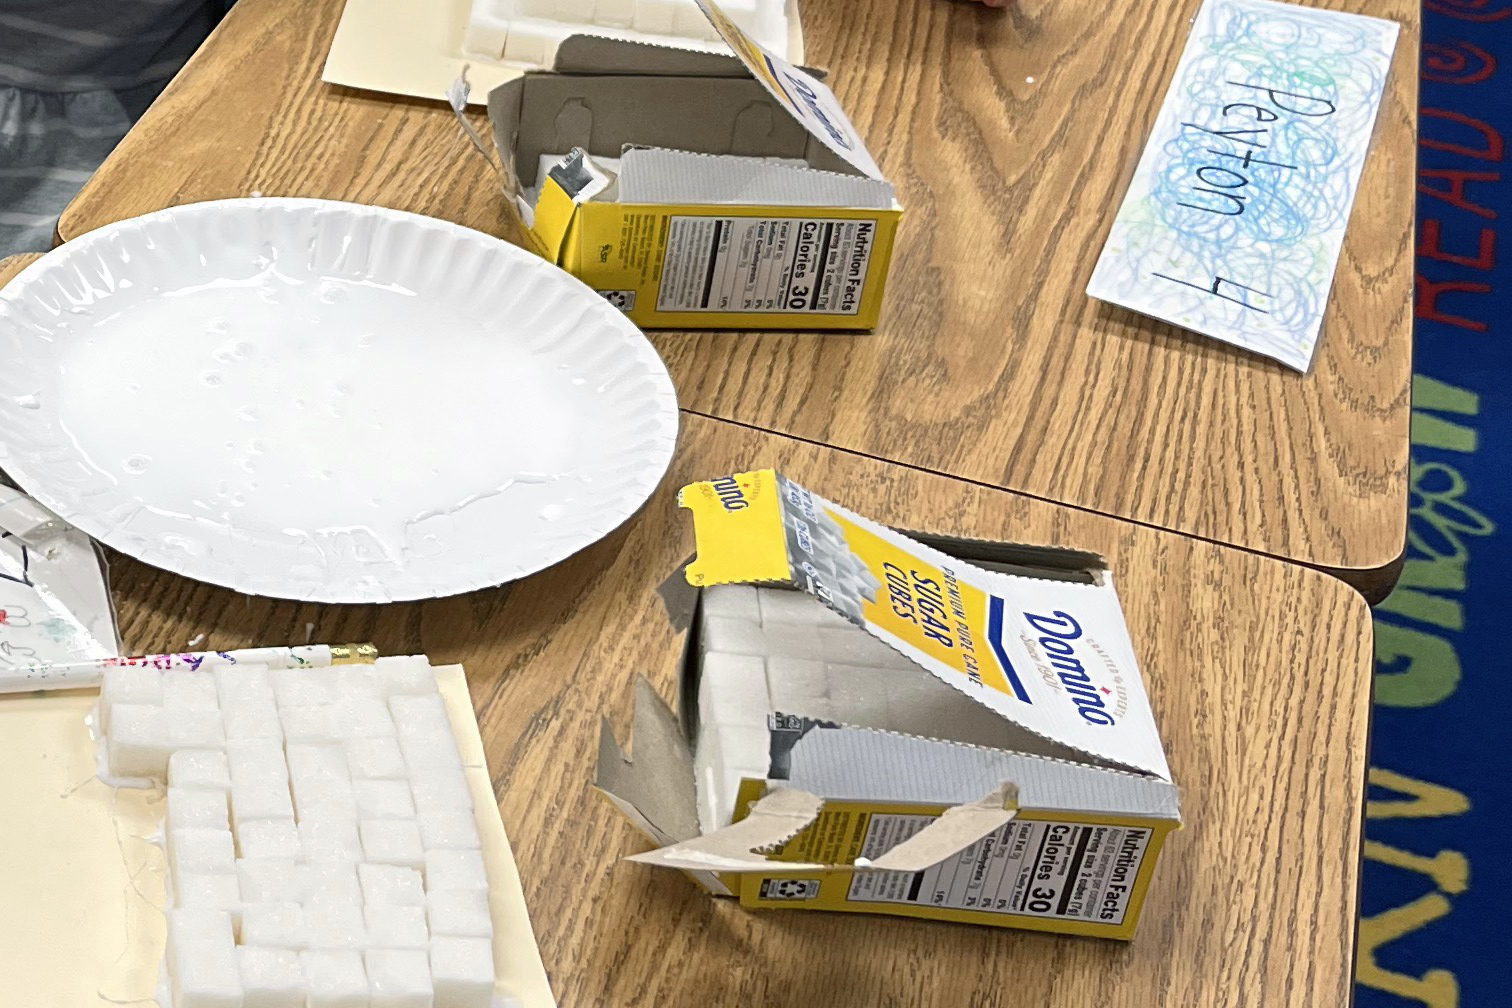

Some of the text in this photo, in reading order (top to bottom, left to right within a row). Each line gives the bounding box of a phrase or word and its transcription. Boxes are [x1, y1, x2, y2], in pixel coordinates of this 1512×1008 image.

[1180, 80, 1337, 216] Peyton
[789, 222, 817, 309] Calories 30
[841, 223, 872, 311] Nutrition Facts
[883, 562, 918, 624] CUBES
[910, 570, 954, 647] SUGAR
[941, 565, 983, 688] PREMIUM PURE CANE
[1023, 610, 1115, 726] Domino
[975, 839, 995, 880] Carbohydrate
[1001, 822, 1016, 845] Sodium
[1015, 840, 1026, 851] Fat
[1019, 822, 1031, 839] Total
[1084, 854, 1097, 869] size
[1087, 828, 1108, 853] Serving
[1028, 825, 1070, 913] Calories 30
[1074, 879, 1088, 900] cubes
[1100, 830, 1146, 919] Nutrition Facts
[1067, 901, 1083, 917] (7g)
